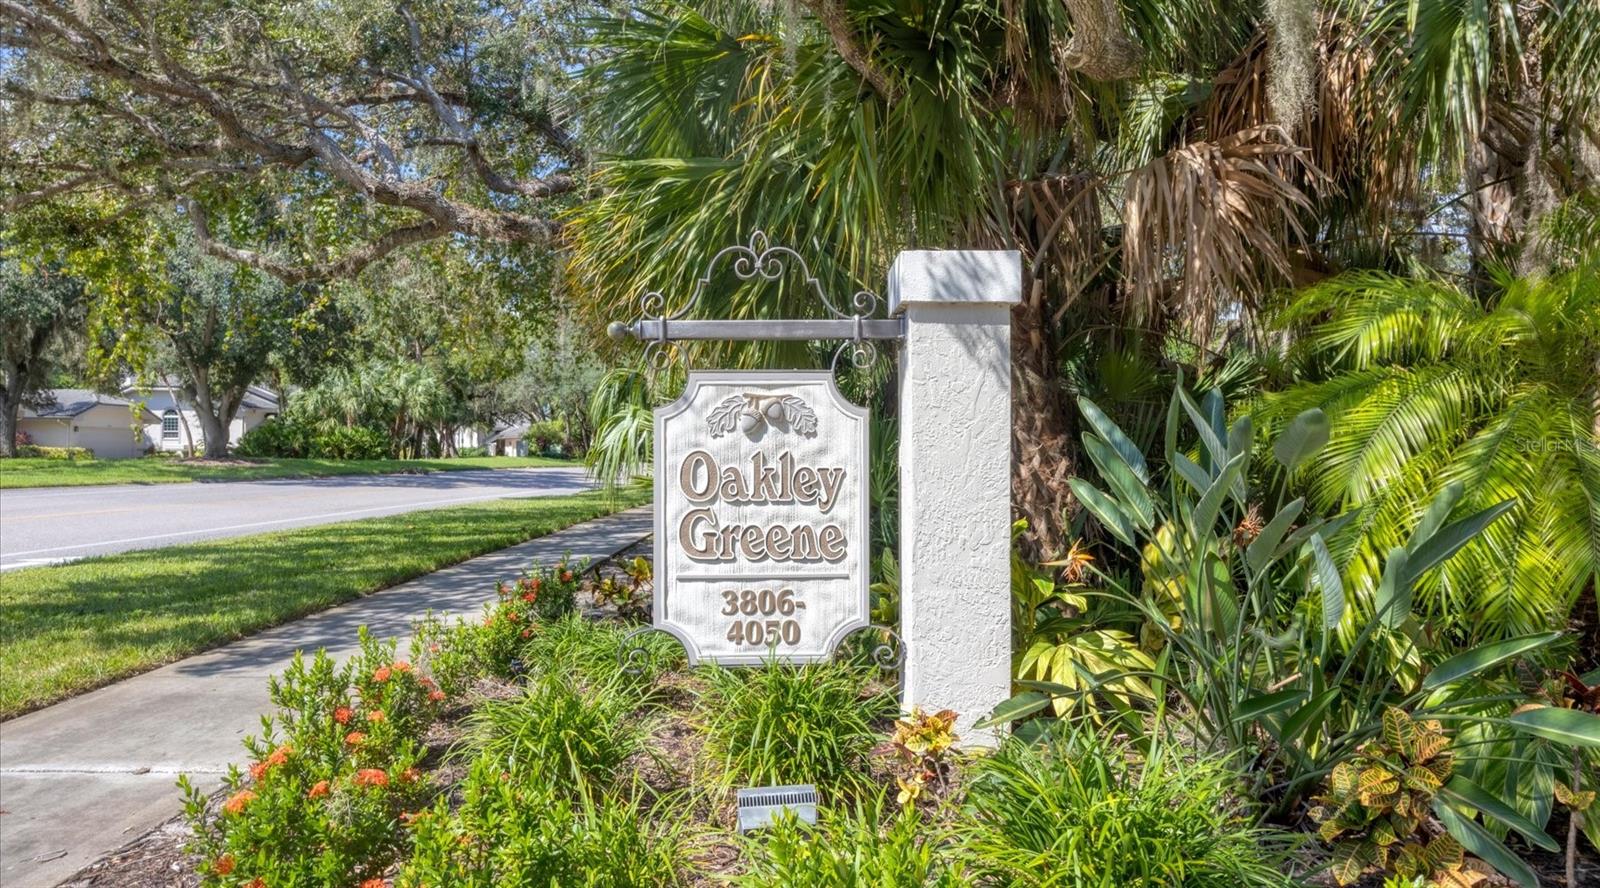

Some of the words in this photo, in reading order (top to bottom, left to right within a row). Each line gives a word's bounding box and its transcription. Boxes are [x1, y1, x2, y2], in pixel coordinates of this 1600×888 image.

[680, 450, 845, 513] Oakley
[679, 507, 847, 562] Greene
[721, 589, 806, 616] 3806-
[727, 620, 801, 645] 4050
